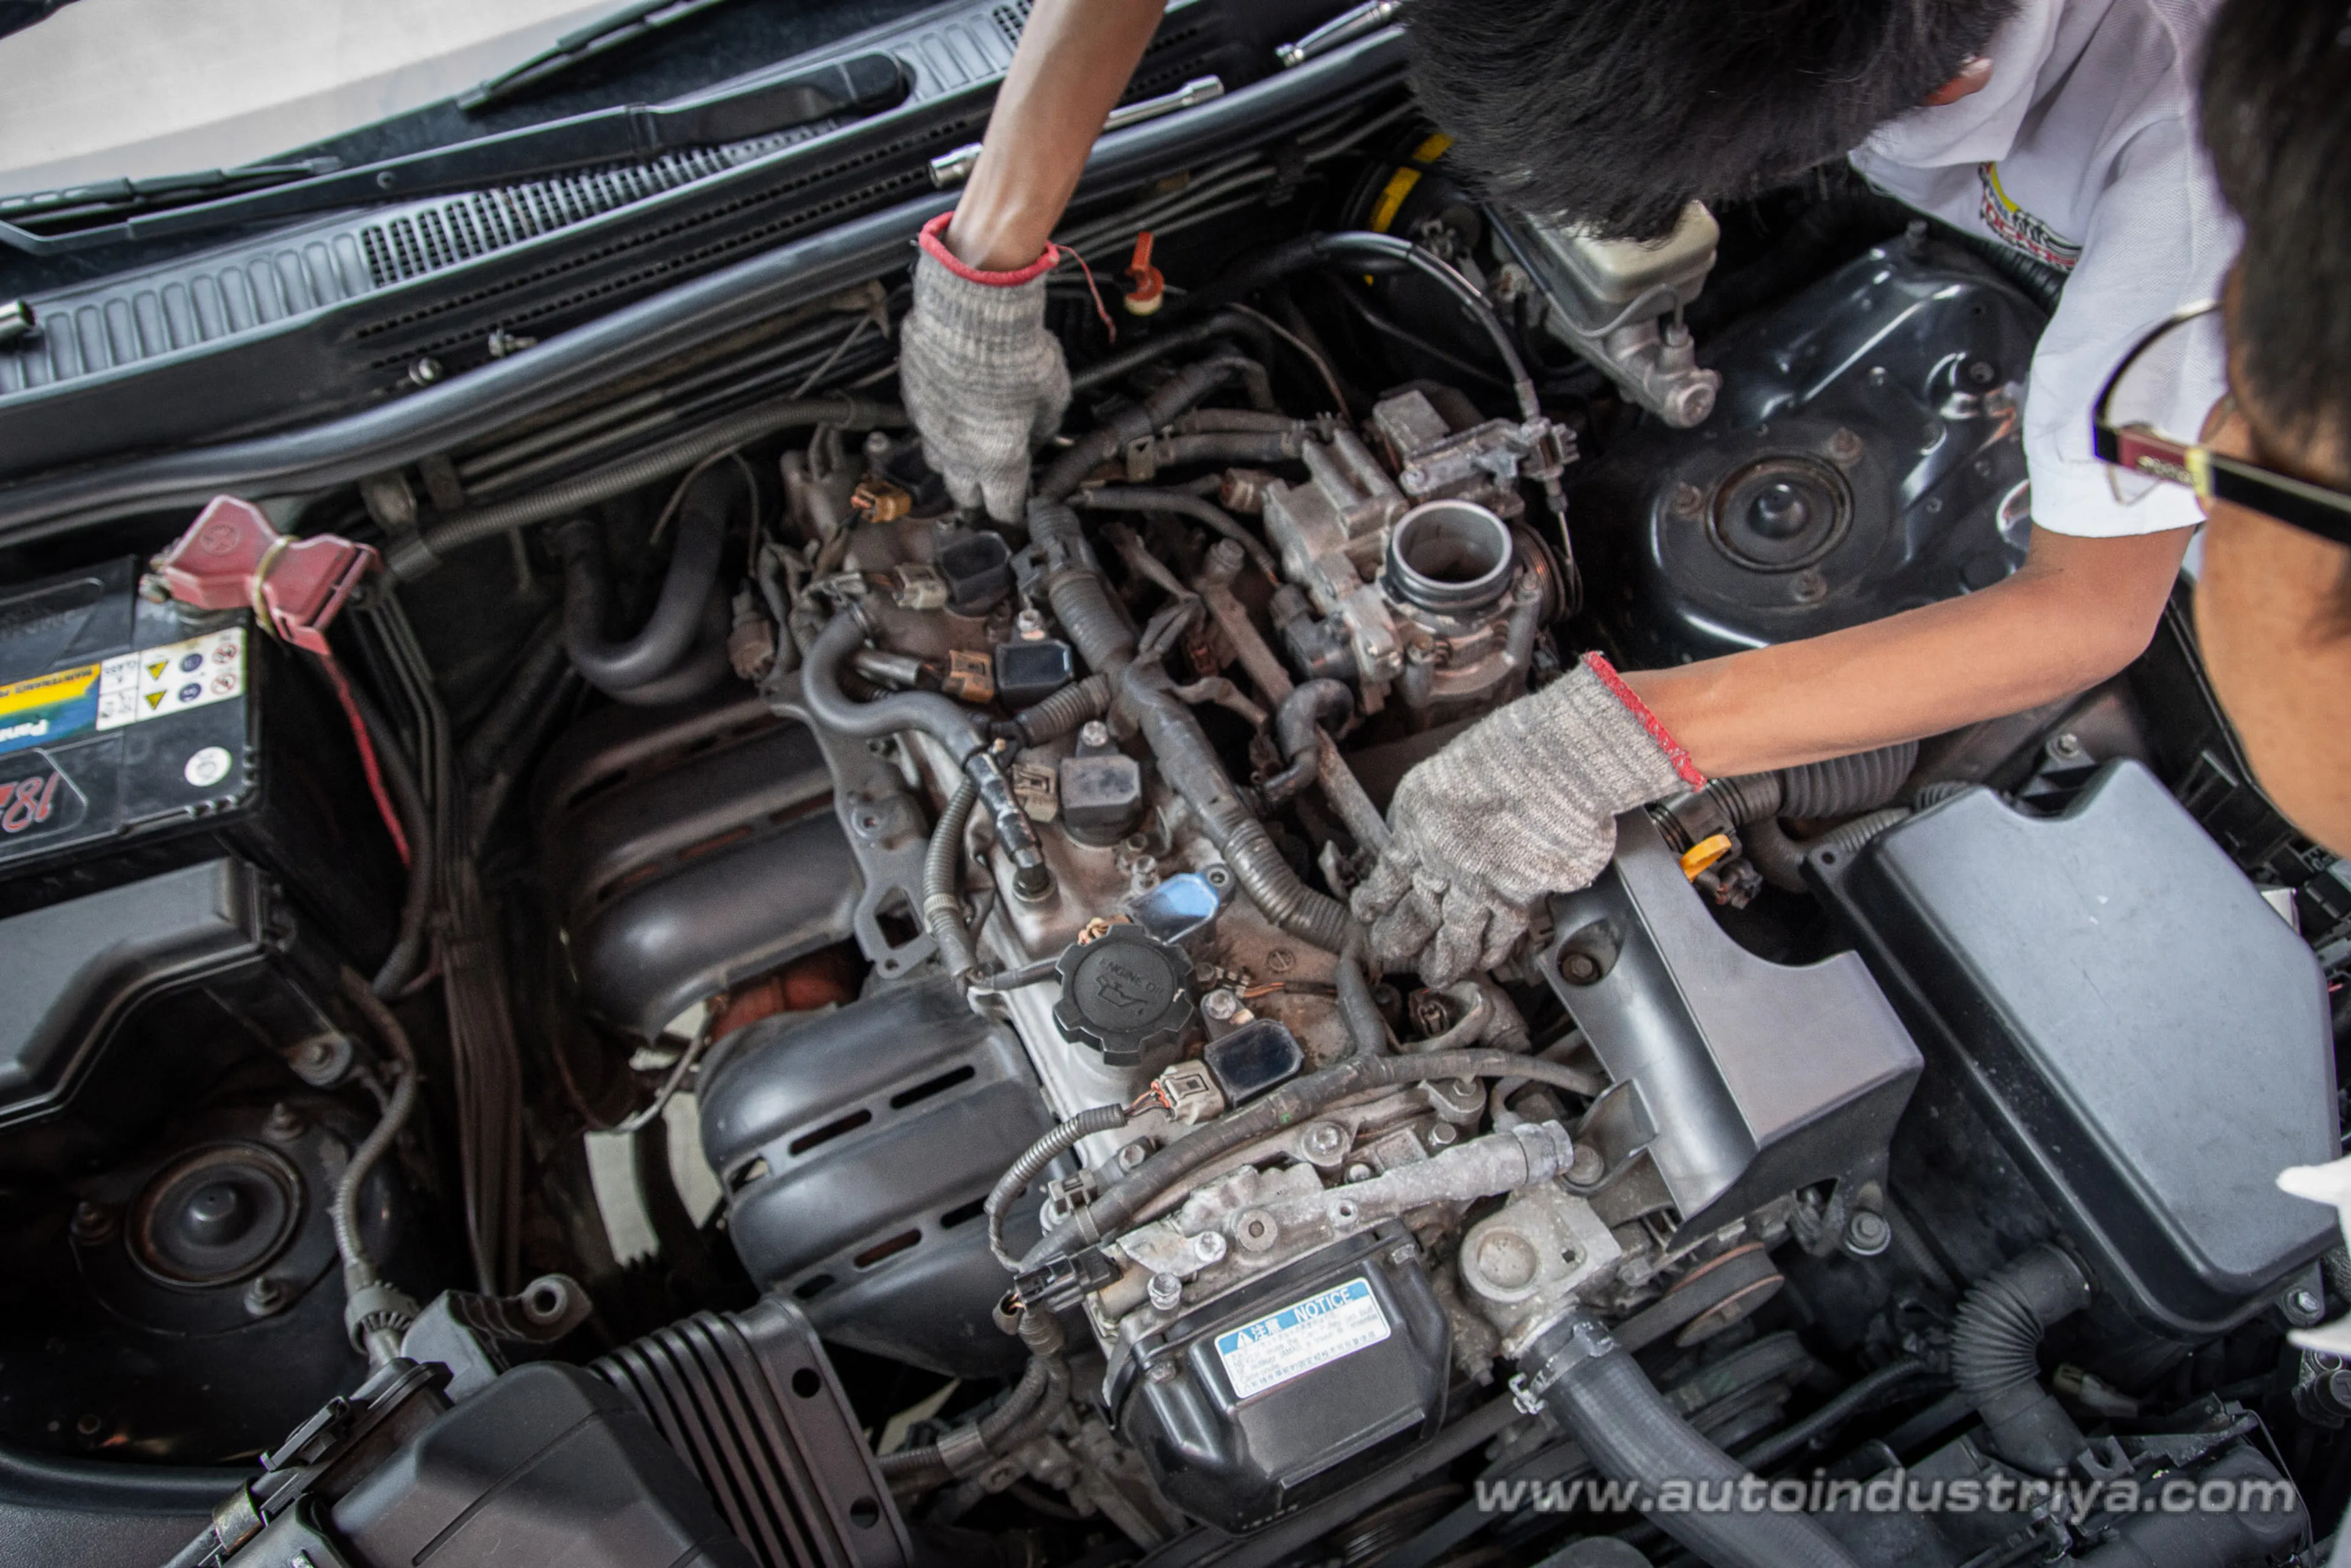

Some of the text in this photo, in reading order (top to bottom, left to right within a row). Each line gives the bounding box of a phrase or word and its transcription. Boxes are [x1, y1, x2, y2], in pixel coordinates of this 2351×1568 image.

[1099, 958, 1164, 999] ENGINE OIL
[1293, 1288, 1352, 1324] NOTICE
